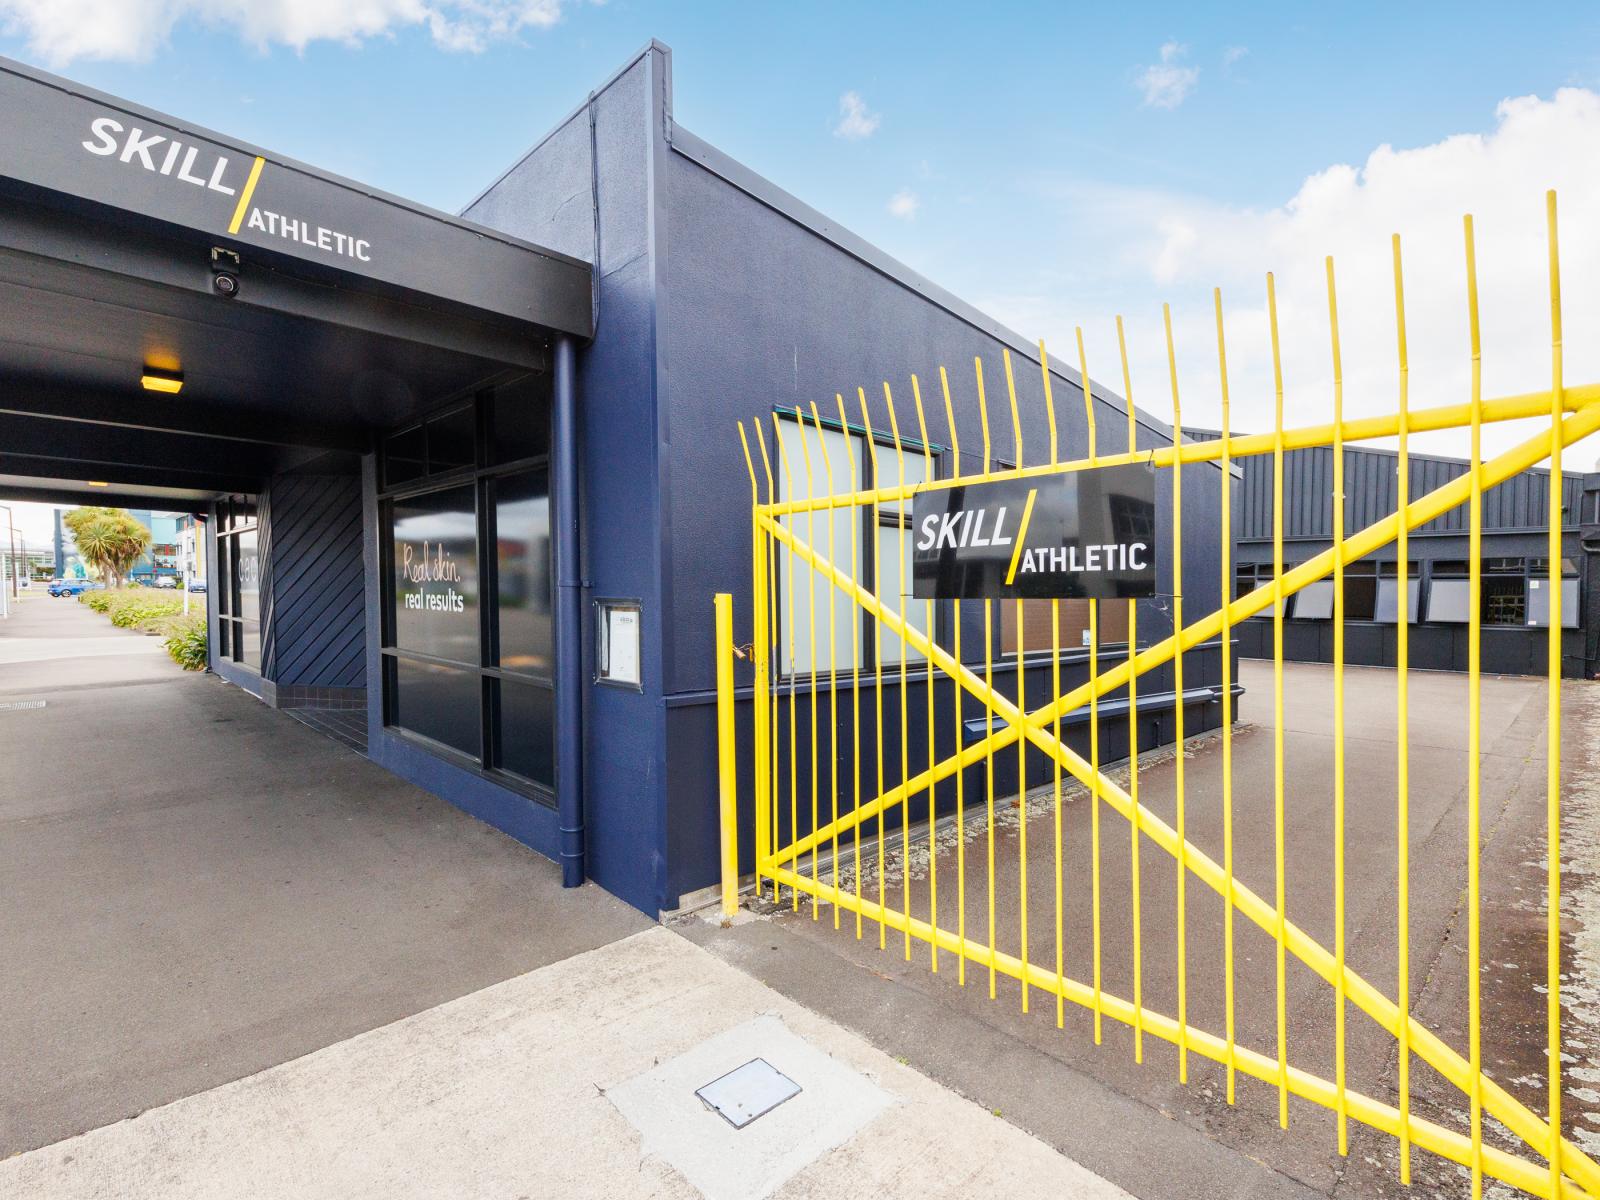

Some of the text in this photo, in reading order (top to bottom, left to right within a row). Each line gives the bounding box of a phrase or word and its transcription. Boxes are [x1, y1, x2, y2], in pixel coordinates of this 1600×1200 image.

[82, 117, 236, 196] SKILL
[248, 207, 371, 262] ATHLETIC
[917, 507, 1012, 551] SKILL
[403, 540, 431, 583] Real
[1021, 542, 1148, 574] ATHLETIC
[405, 587, 464, 613] real results
